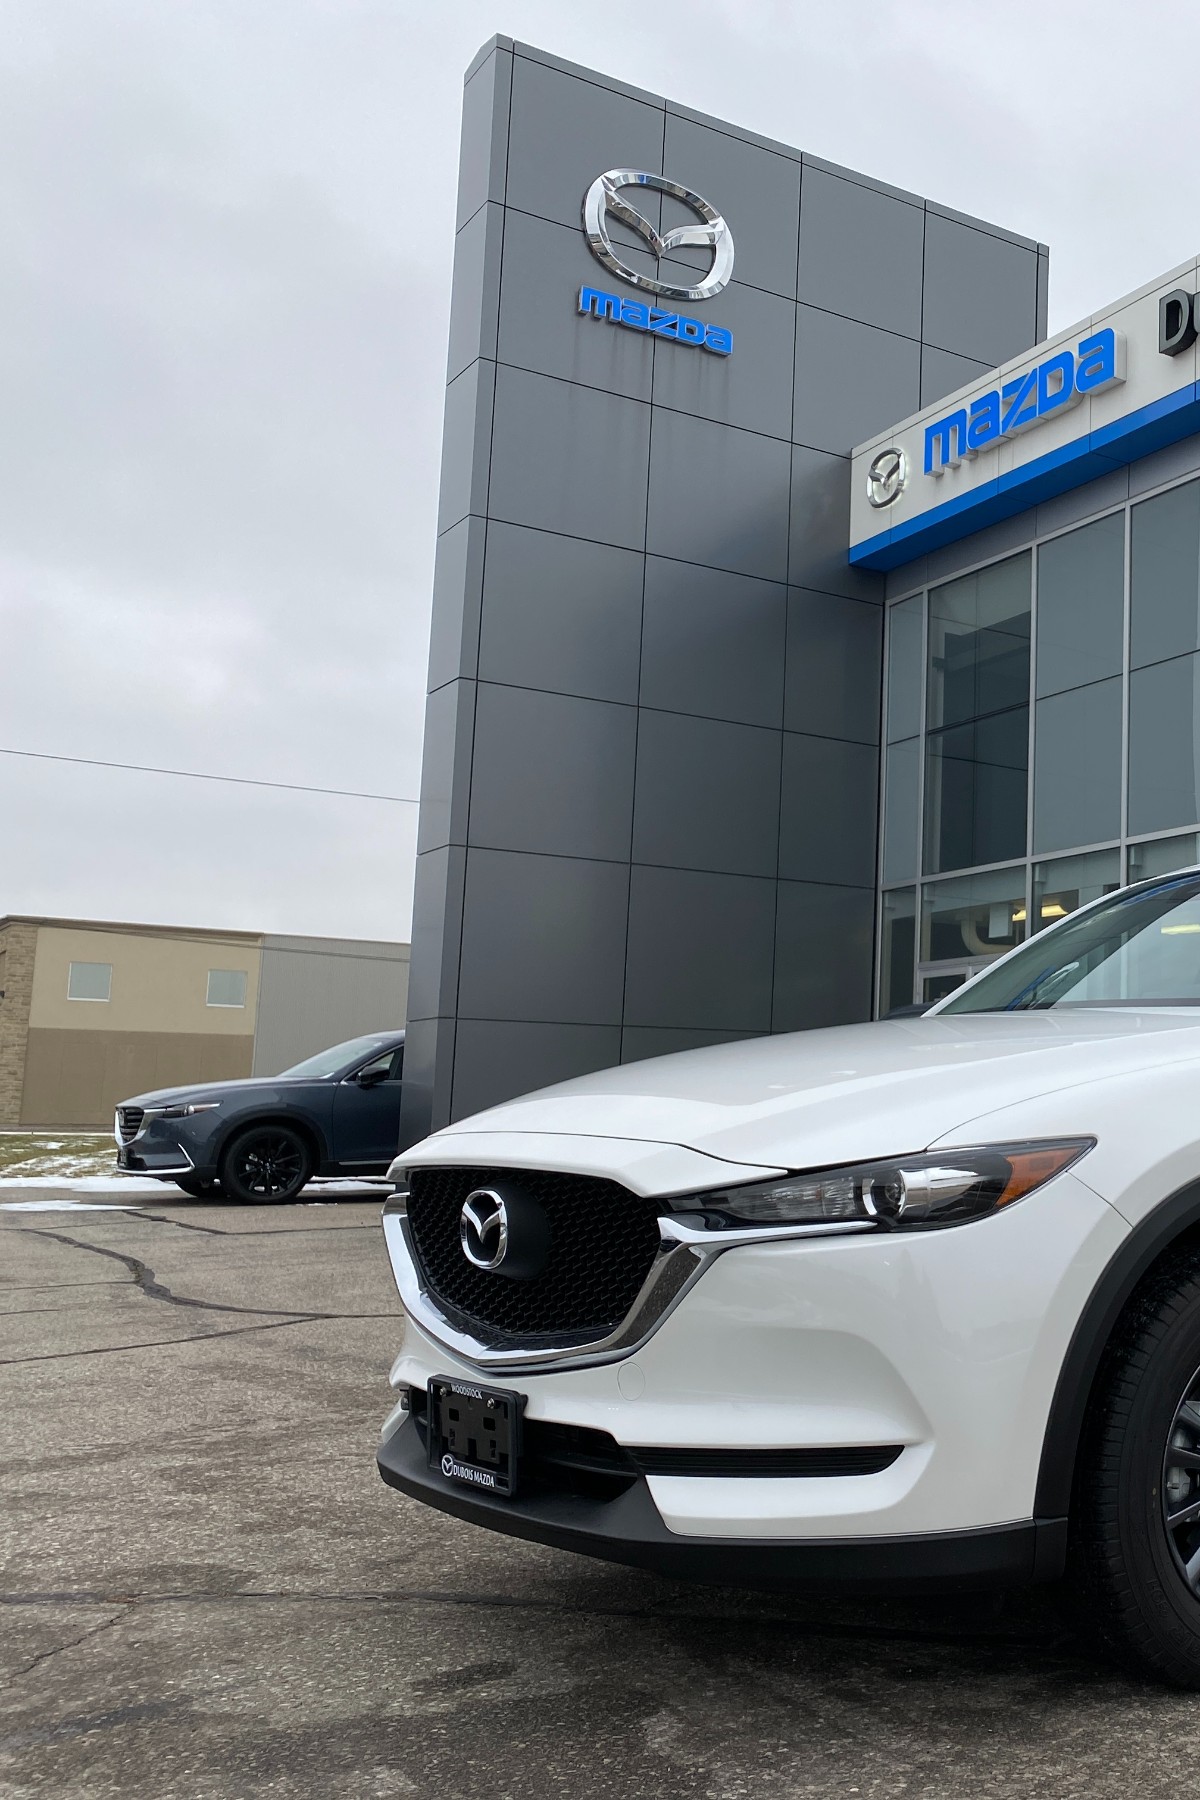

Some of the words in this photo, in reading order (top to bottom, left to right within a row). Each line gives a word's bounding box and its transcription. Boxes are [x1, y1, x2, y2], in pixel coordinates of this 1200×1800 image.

[450, 1383, 483, 1400] WOODSTOCK
[453, 1464, 474, 1481] DUBOIS
[473, 1469, 495, 1488] MAZDA
